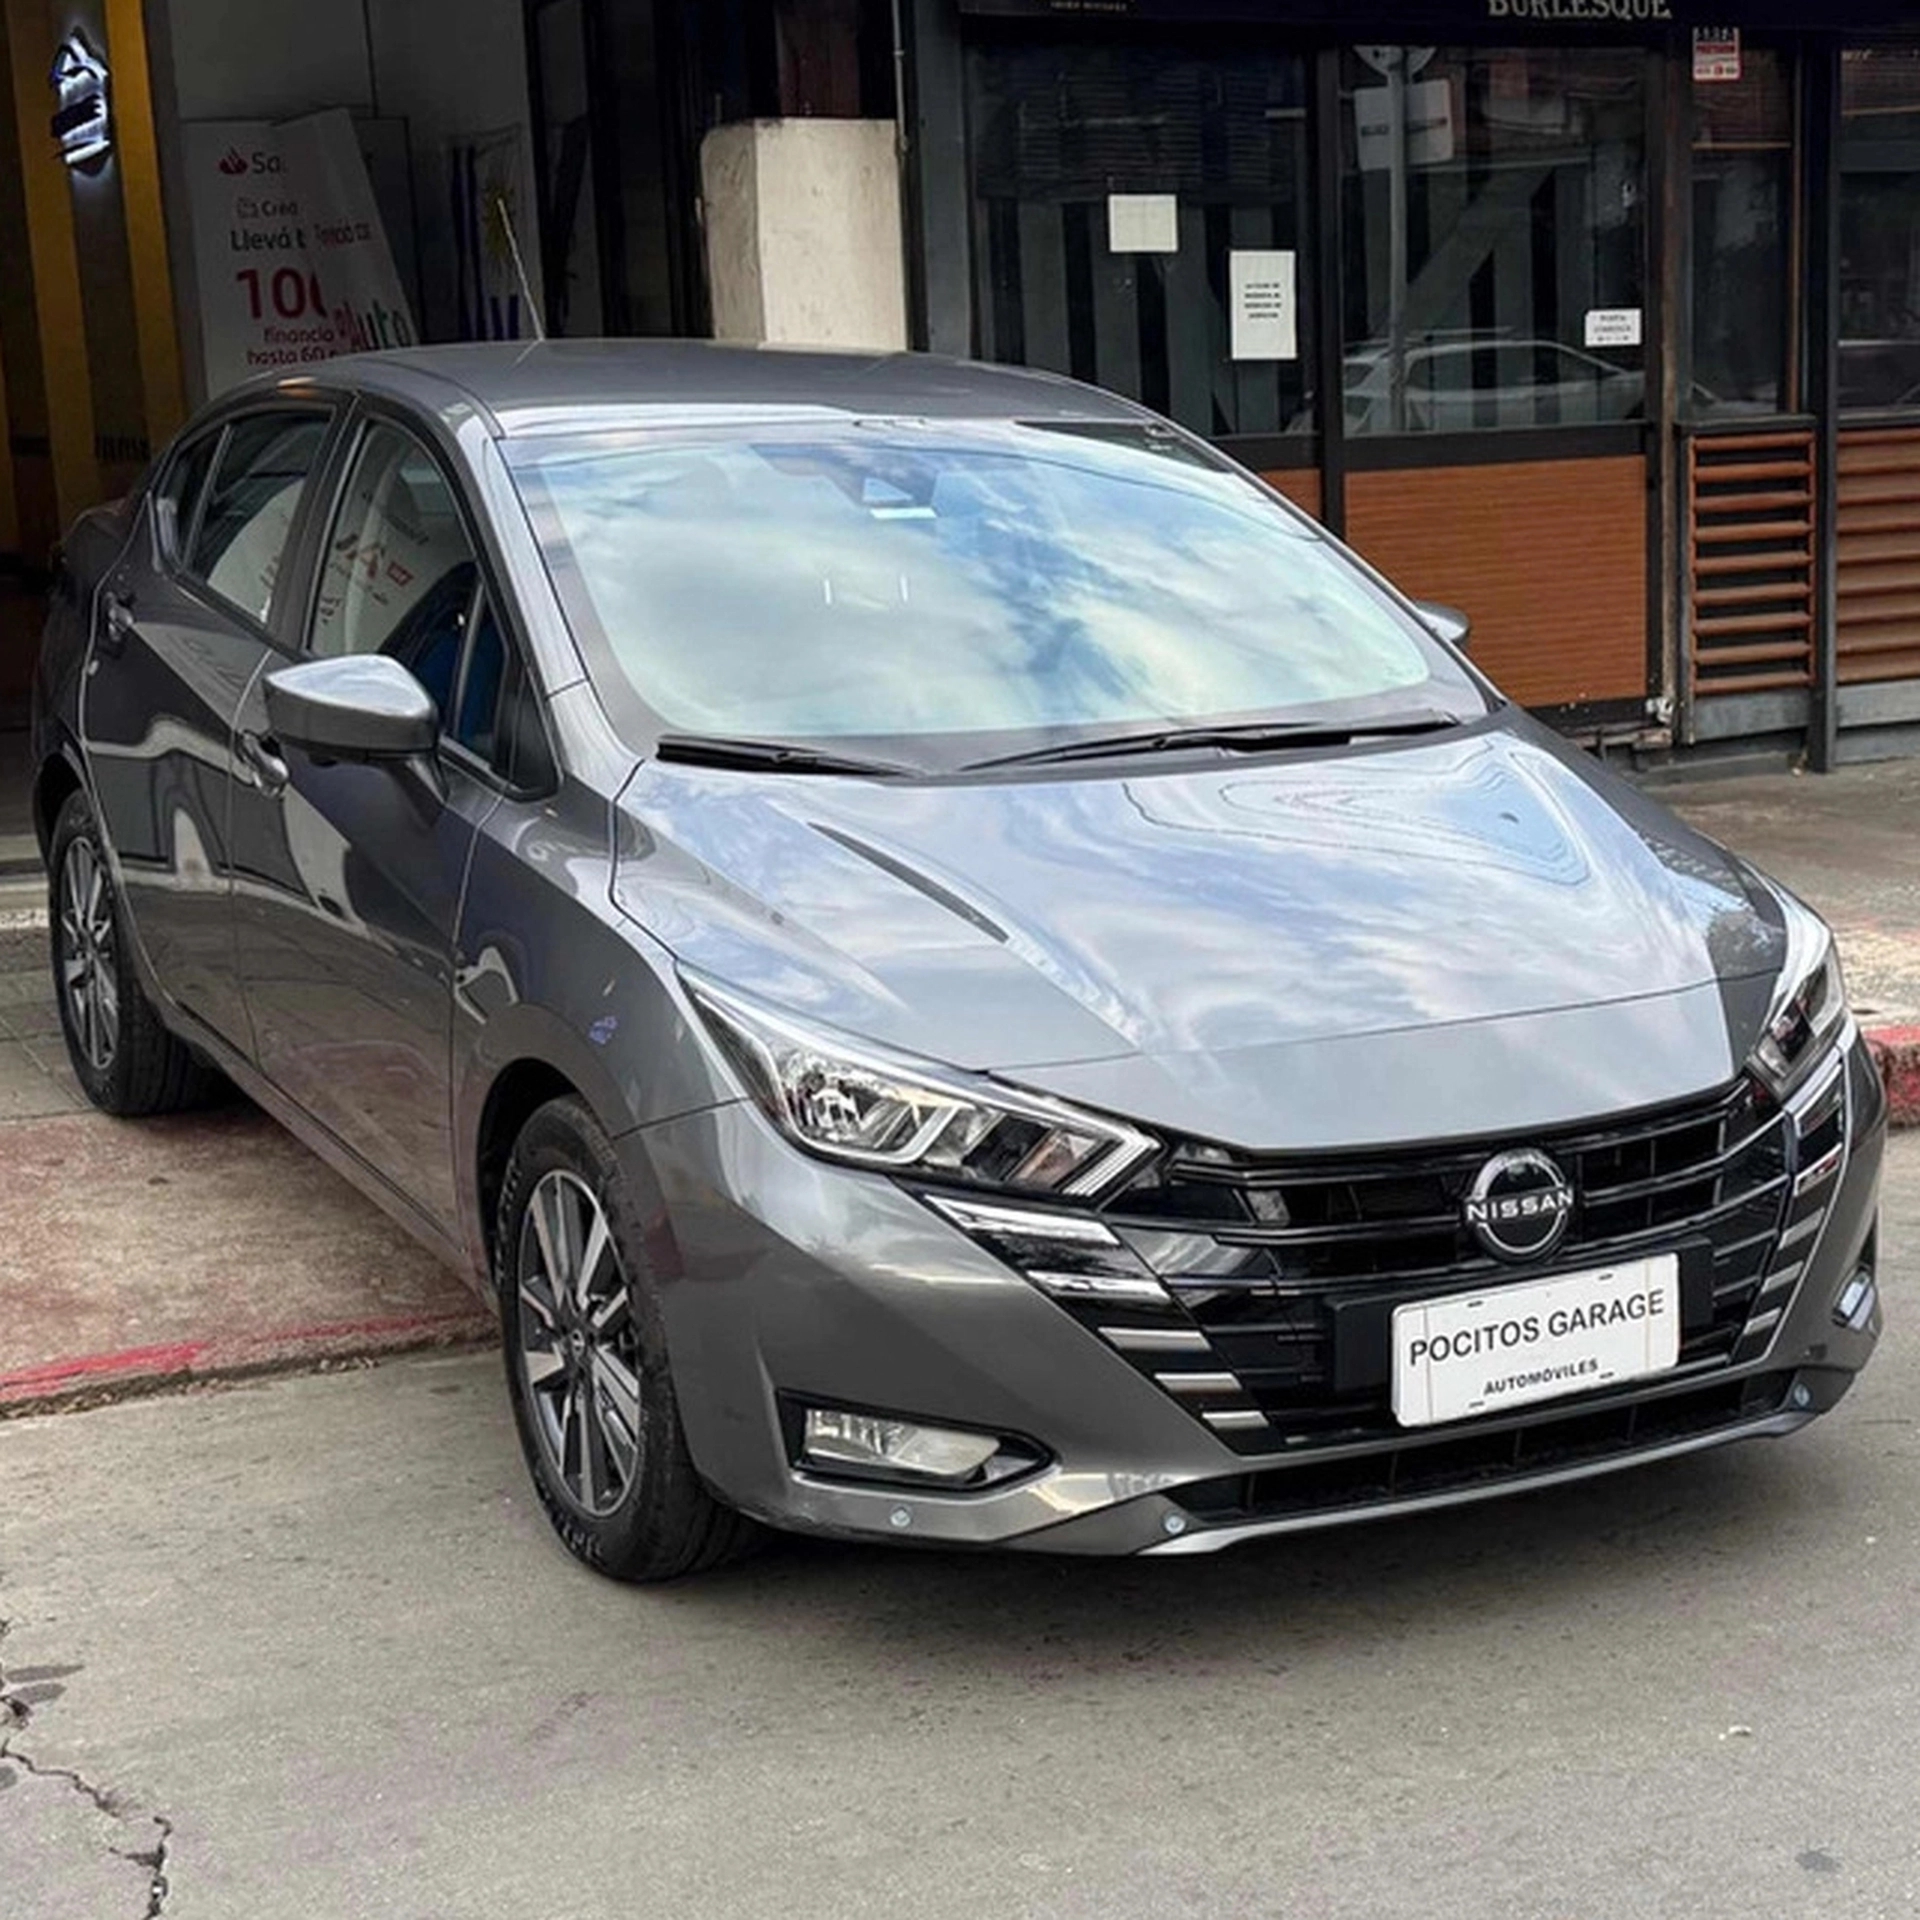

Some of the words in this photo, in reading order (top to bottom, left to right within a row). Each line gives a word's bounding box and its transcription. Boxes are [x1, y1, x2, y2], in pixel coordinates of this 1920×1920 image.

[1488, 0, 1671, 19] BURLESQUE
[230, 226, 292, 251] Llevá
[246, 348, 297, 365] hasta
[301, 347, 325, 363] 60
[1467, 1187, 1573, 1221] NISSAN
[1410, 1317, 1539, 1366] POCITOS
[1548, 1289, 1664, 1337] GARAGE
